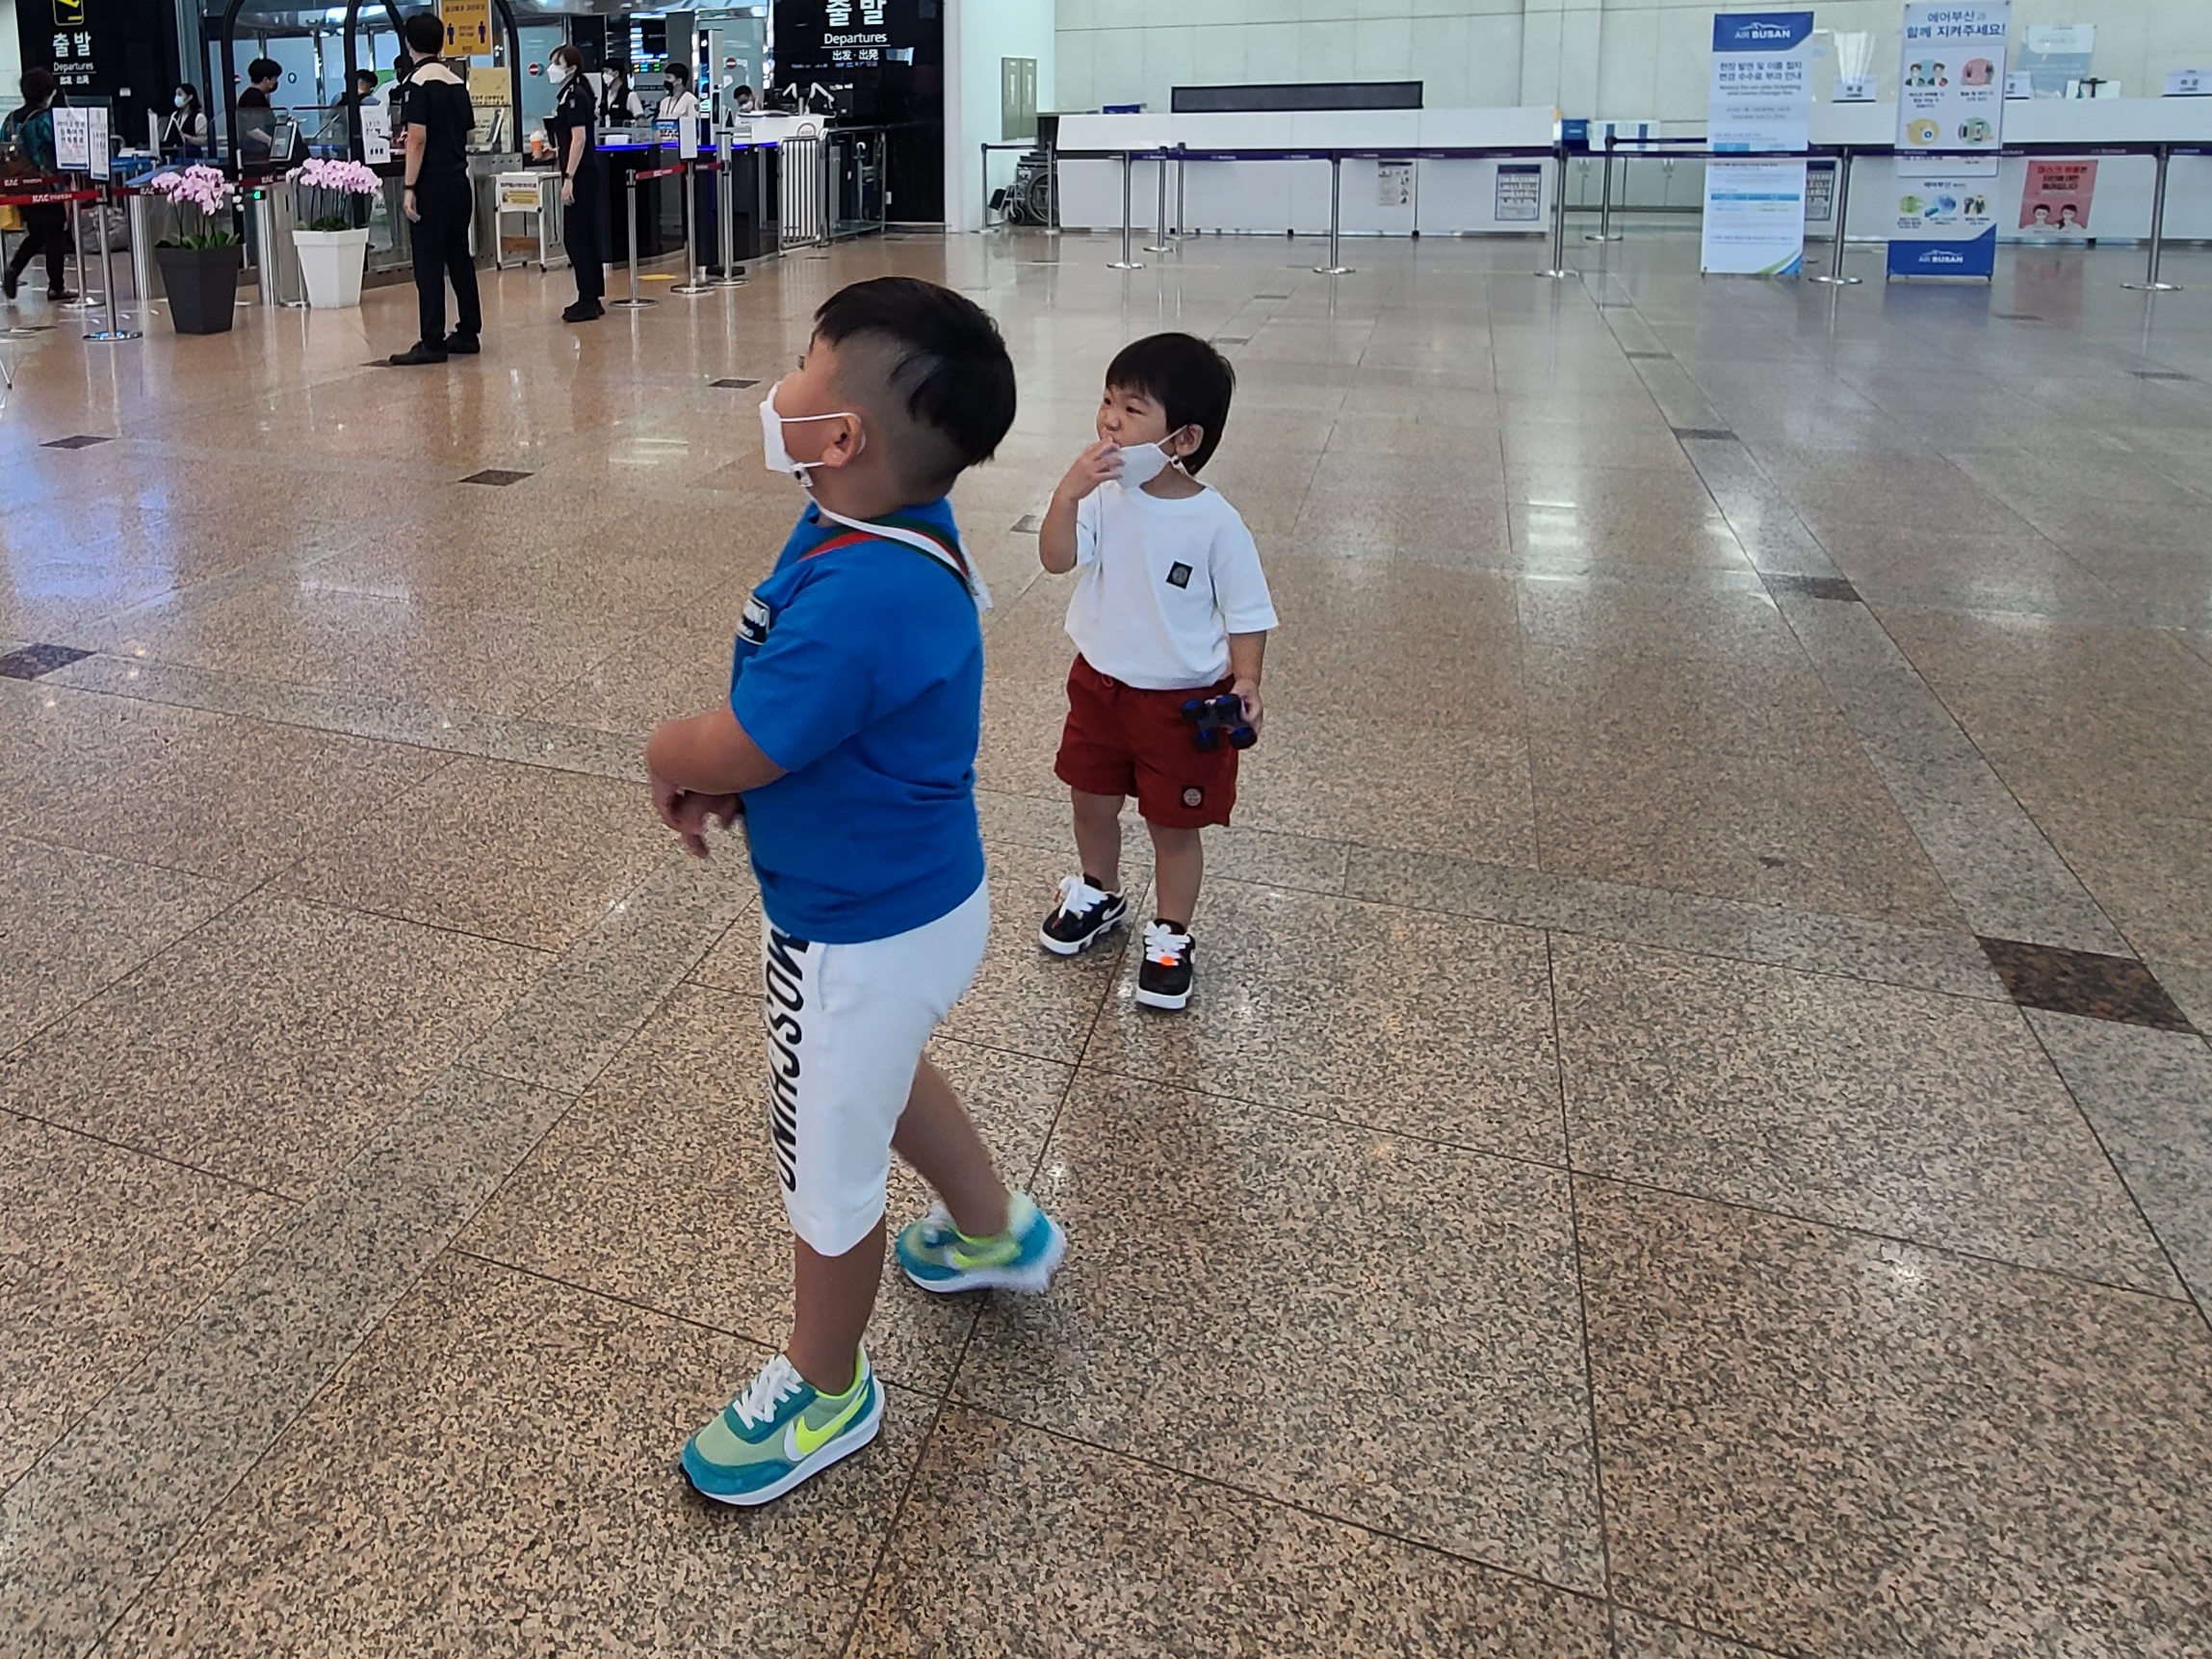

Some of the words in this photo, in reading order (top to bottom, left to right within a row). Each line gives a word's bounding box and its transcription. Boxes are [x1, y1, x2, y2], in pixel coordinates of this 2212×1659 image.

[825, 0, 887, 27] 출발
[1734, 31, 1750, 39] AIR
[1752, 30, 1790, 39] BUSAN
[1937, 23, 2005, 38] 지켜주세요!
[53, 31, 91, 58] 출발
[824, 33, 887, 46] Departures
[53, 62, 94, 74] Departures
[1932, 255, 1964, 264] BUSAN
